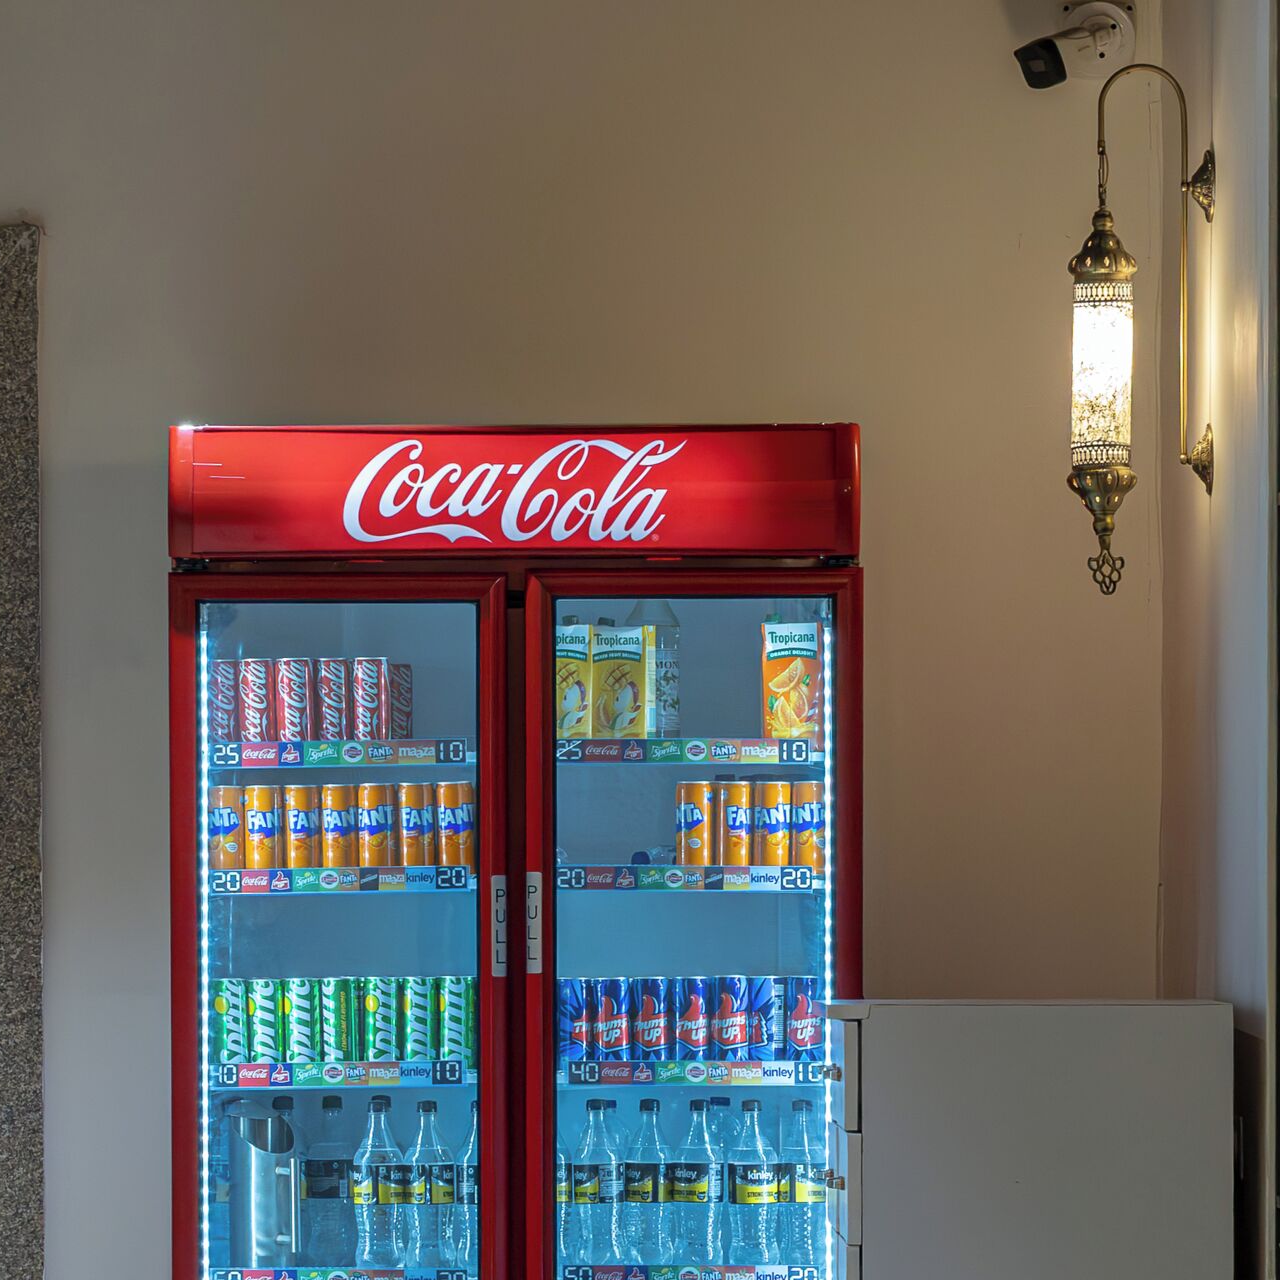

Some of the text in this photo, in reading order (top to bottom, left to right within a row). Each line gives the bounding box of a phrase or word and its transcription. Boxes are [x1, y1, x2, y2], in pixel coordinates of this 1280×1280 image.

[342, 439, 688, 543] Coca-Cola
[593, 633, 640, 648] Tropicana
[768, 631, 815, 646] Tropicana
[214, 744, 239, 764] 25
[439, 742, 463, 761] 10
[711, 744, 737, 756] FANTA
[741, 744, 778, 758] maaza
[783, 742, 805, 761] 10
[213, 872, 239, 891] 20
[405, 872, 435, 884] kinley
[438, 868, 465, 886] 20
[557, 869, 584, 888] 20
[685, 873, 702, 882] FANTA
[750, 873, 780, 885] kinley
[783, 868, 810, 888] 20
[496, 889, 506, 964] PULL
[528, 885, 538, 960] PULL
[602, 1028, 621, 1043] UP
[643, 1027, 662, 1043] UP
[722, 1027, 740, 1041] UP
[797, 1027, 815, 1041] UP
[400, 1067, 432, 1078] kinley
[436, 1062, 459, 1081] 10
[572, 1063, 599, 1082] 40
[708, 1067, 728, 1077] FANTA
[732, 1067, 761, 1079] maaza
[762, 1067, 793, 1078] kinley
